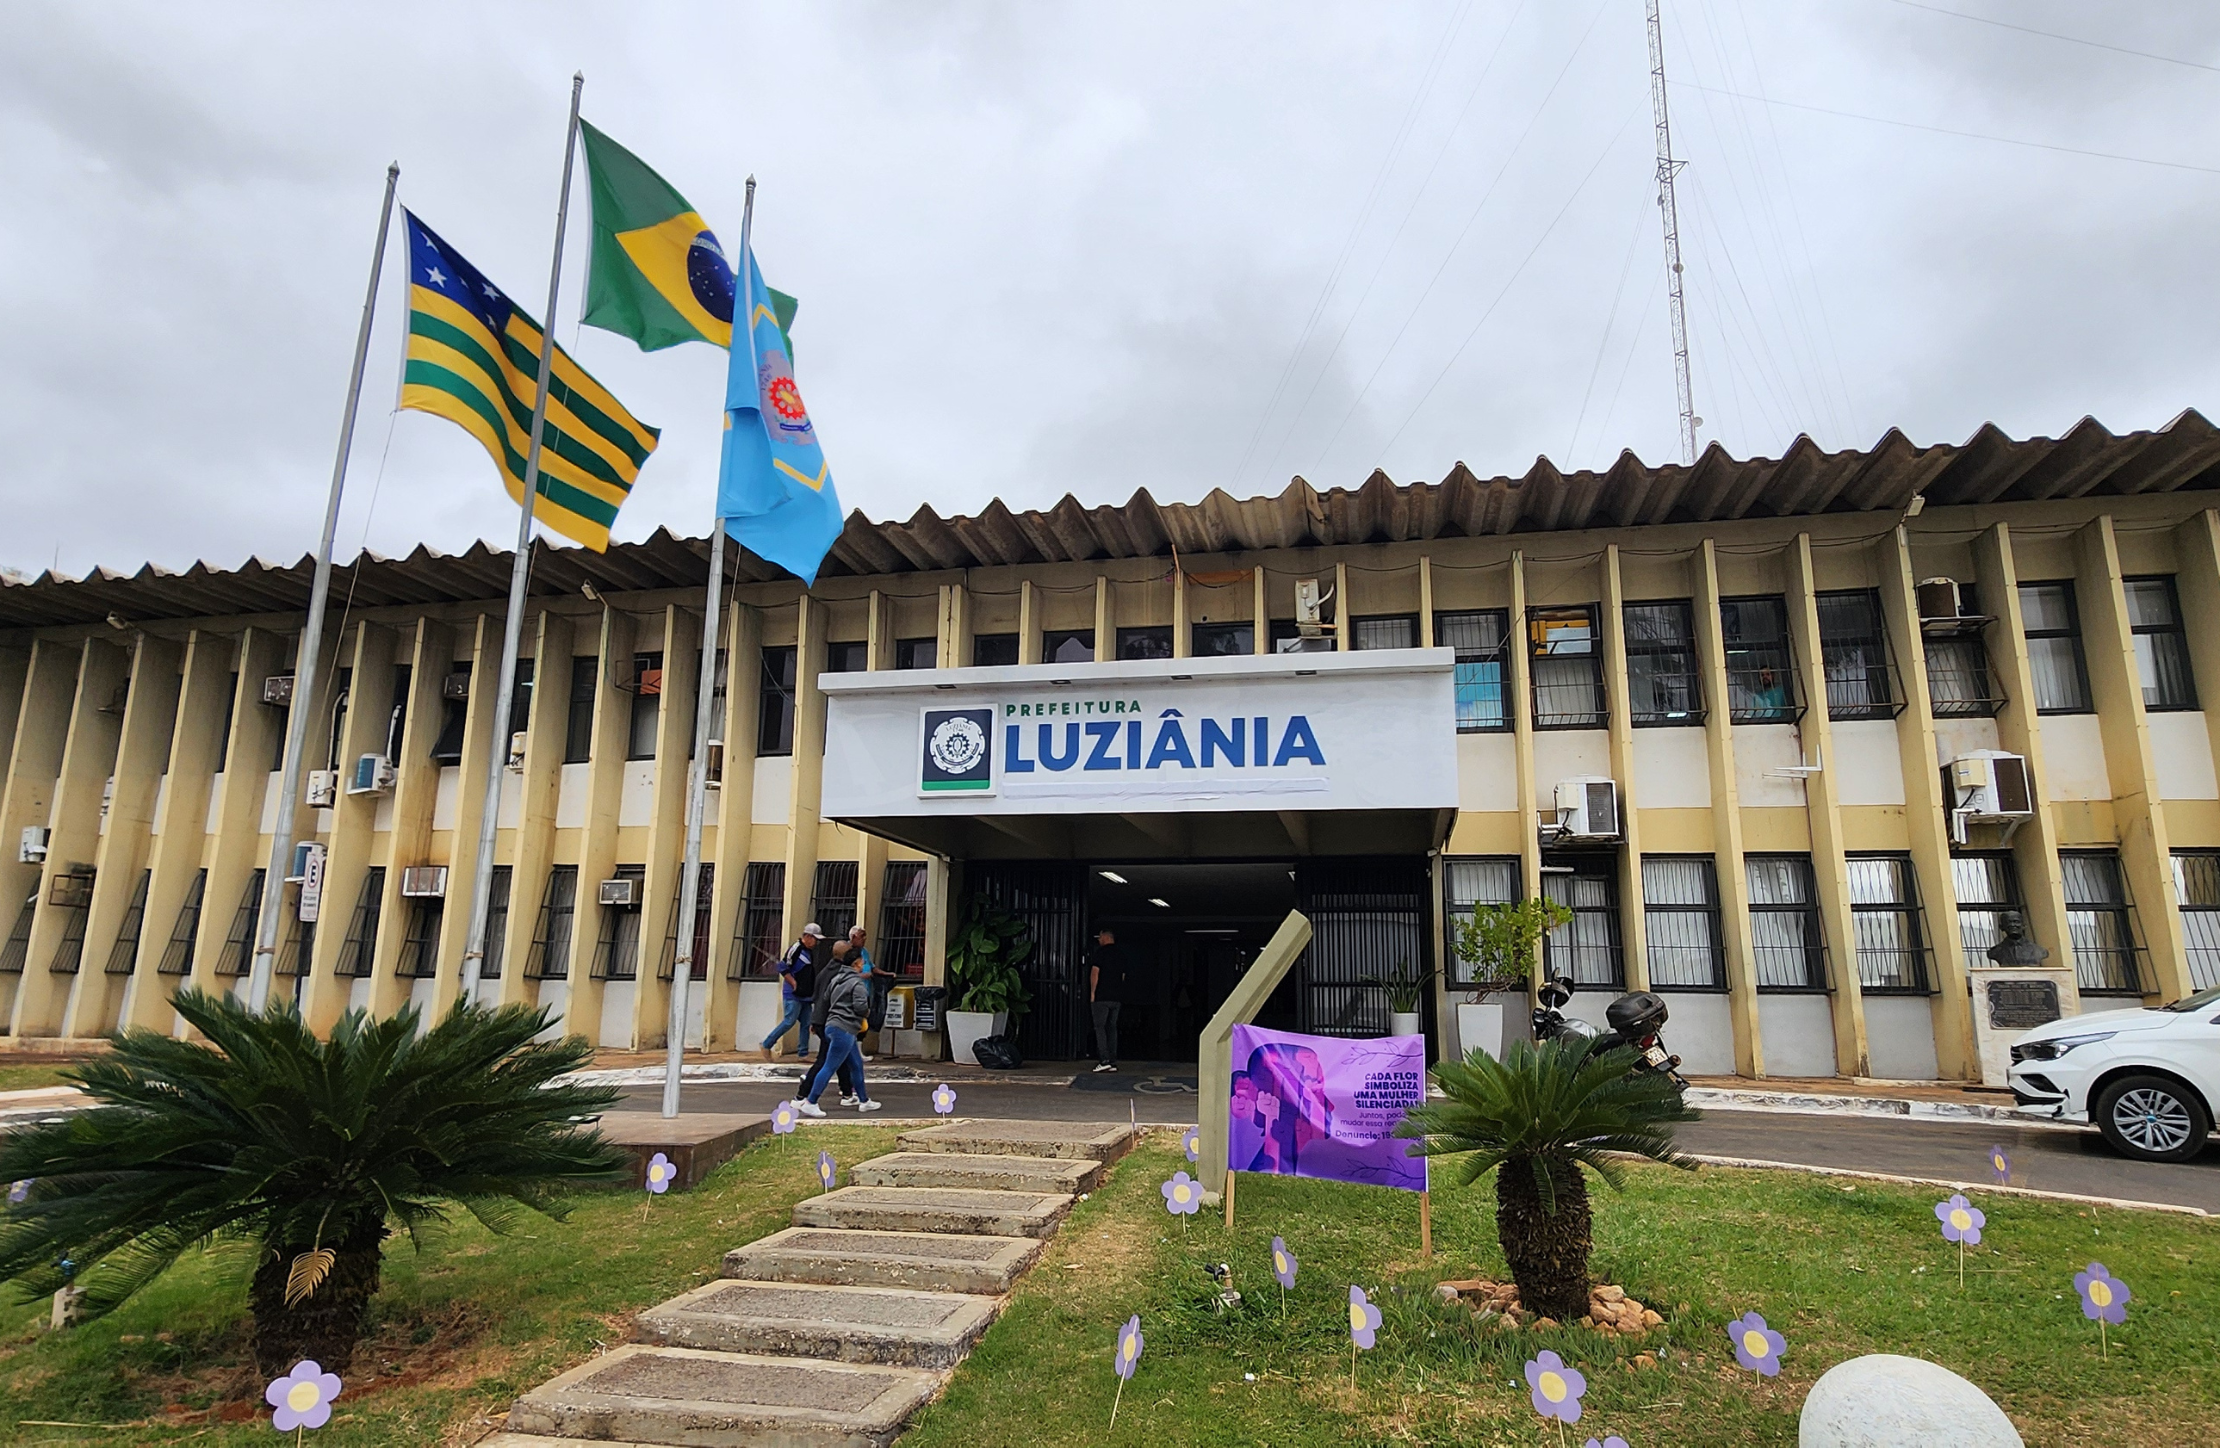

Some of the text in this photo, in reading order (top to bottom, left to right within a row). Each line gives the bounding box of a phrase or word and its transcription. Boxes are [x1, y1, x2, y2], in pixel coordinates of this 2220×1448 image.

[1005, 699, 1142, 717] PREFEITURA
[1004, 708, 1326, 774] LUZIÂNIA
[310, 866, 316, 882] E
[1365, 1072, 1419, 1081] CADA FLOR
[1364, 1081, 1419, 1090] SIMBOLIZA
[1353, 1091, 1419, 1100] UMA MULHER
[1359, 1112, 1385, 1120] Juntos,
[1340, 1119, 1364, 1127] mudar
